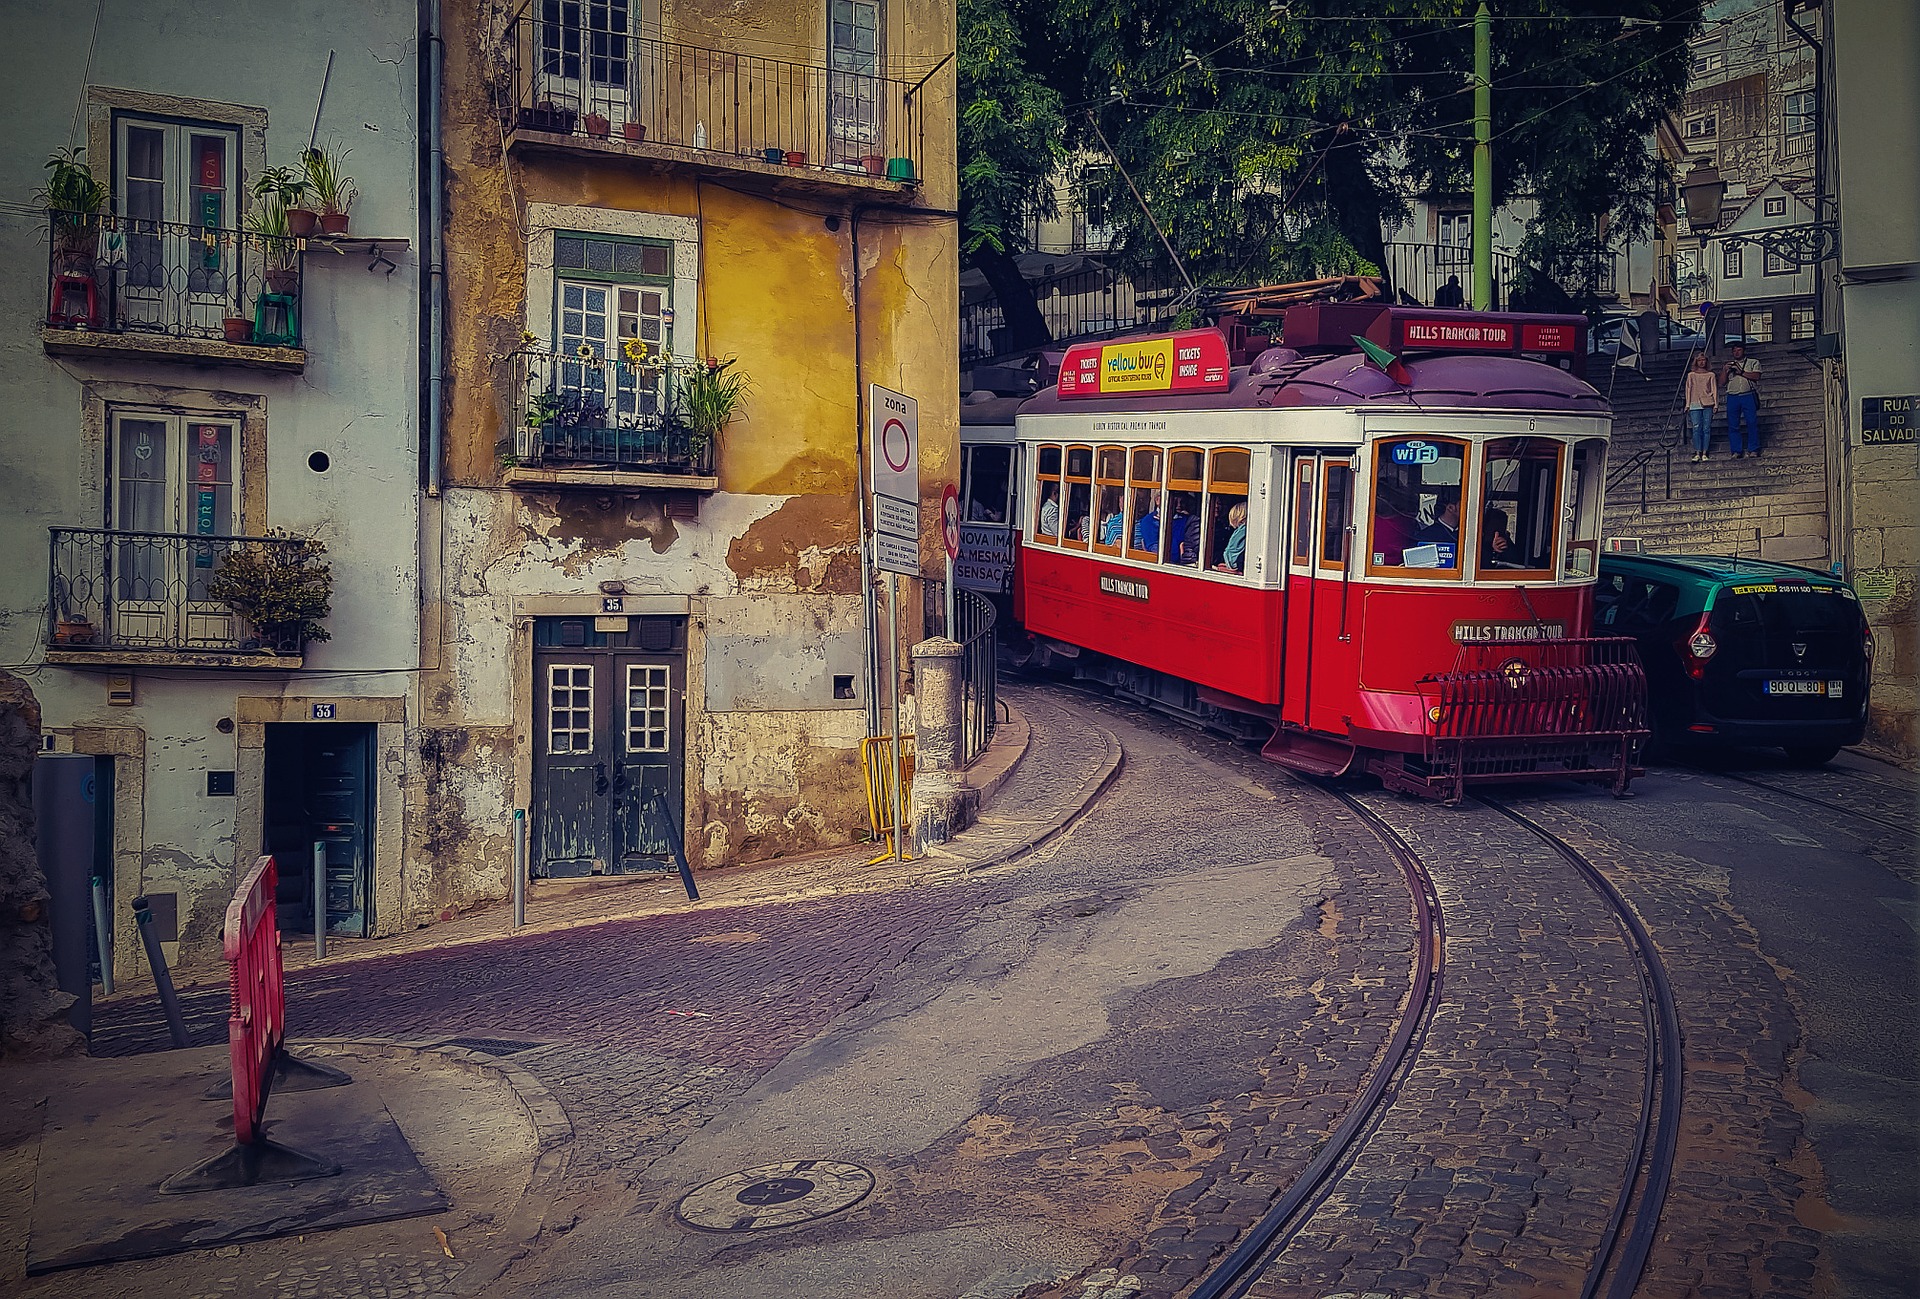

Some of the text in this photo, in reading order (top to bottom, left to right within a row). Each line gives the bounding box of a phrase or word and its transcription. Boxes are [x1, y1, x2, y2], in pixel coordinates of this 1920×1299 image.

[1409, 326, 1438, 340] HILLS
[1482, 328, 1507, 342] TOUR
[1179, 347, 1201, 361] TICKETS
[1179, 364, 1198, 377] INSIDE
[885, 397, 907, 414] zona
[1883, 399, 1911, 412] RUA
[1528, 418, 1536, 431] 6
[1889, 415, 1905, 425] DO
[960, 531, 1016, 548] NOVA IMA
[969, 550, 1009, 564] MESMA
[957, 565, 1002, 583] SENSAÇ
[1732, 585, 1778, 595] TELETAXIS
[1455, 625, 1491, 640] HILLS
[316, 704, 331, 718] 33
